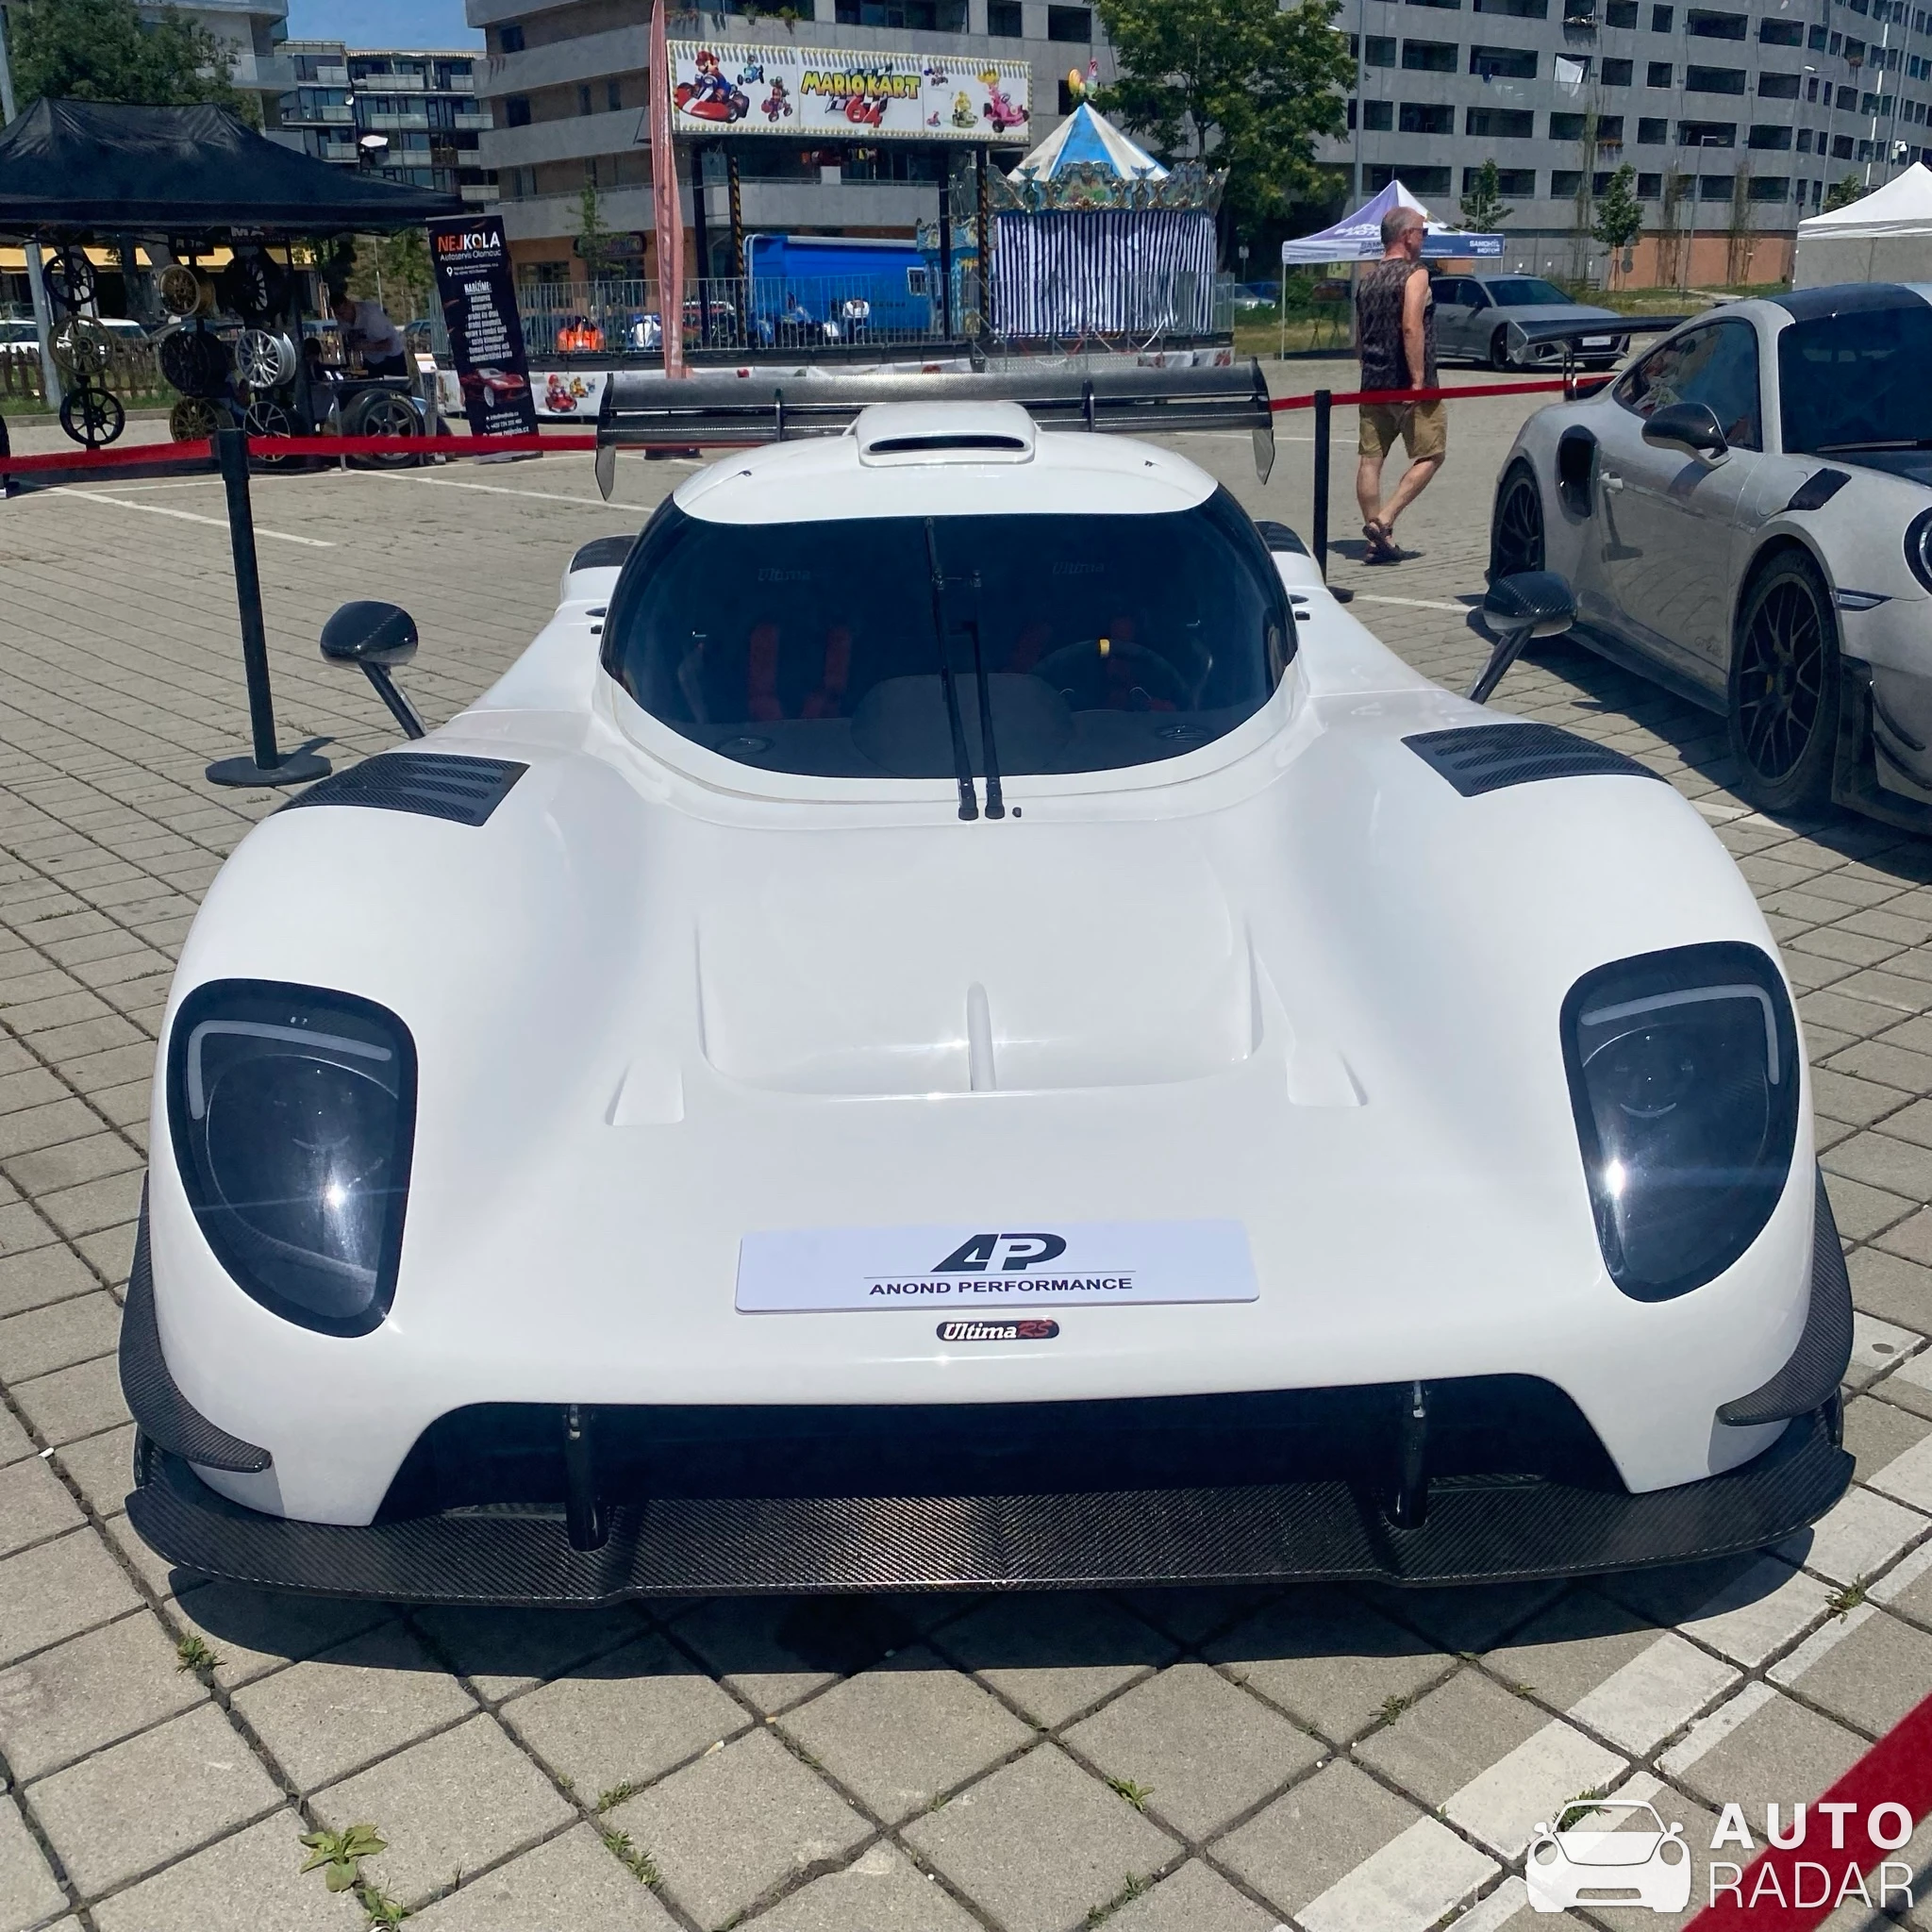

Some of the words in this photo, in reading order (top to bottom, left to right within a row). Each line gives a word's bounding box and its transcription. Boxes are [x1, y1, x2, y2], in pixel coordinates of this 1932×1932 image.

[845, 94, 883, 128] 64
[438, 231, 501, 253] NEJKOLA
[440, 252, 472, 261] Autoservis
[473, 249, 501, 258] Olomouc
[757, 567, 812, 582] Ultima
[1052, 560, 1105, 575] Ultima
[930, 1233, 1067, 1273] AP
[869, 1283, 951, 1295] ANOND
[958, 1278, 1133, 1293] PERFORMANCE
